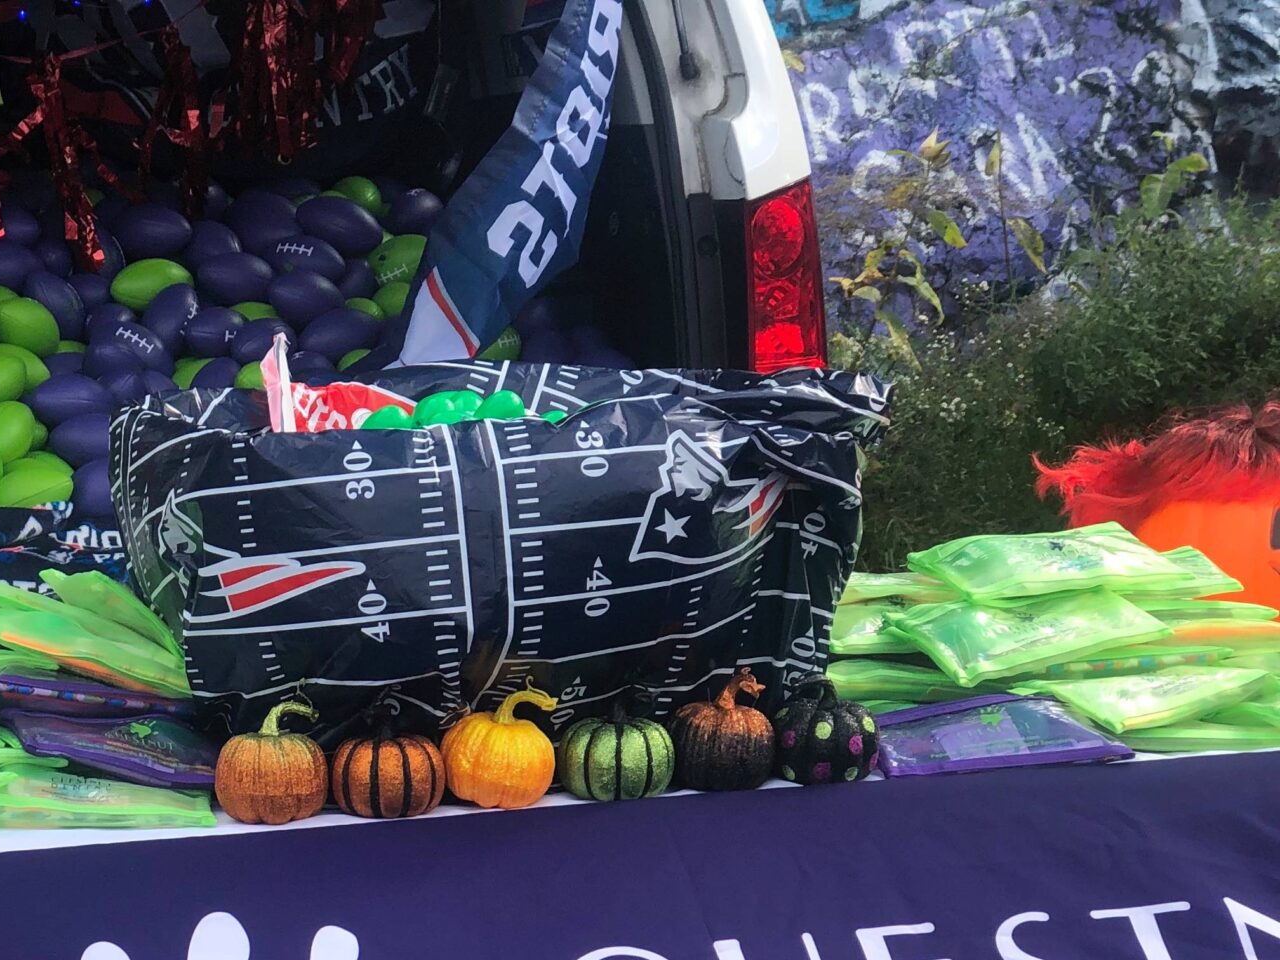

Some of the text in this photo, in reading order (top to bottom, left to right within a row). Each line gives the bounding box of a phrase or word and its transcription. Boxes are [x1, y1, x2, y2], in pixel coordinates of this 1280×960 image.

[343, 452, 375, 499] 30
[576, 430, 609, 477] 30
[584, 570, 612, 617] 40
[358, 593, 390, 643] 40
